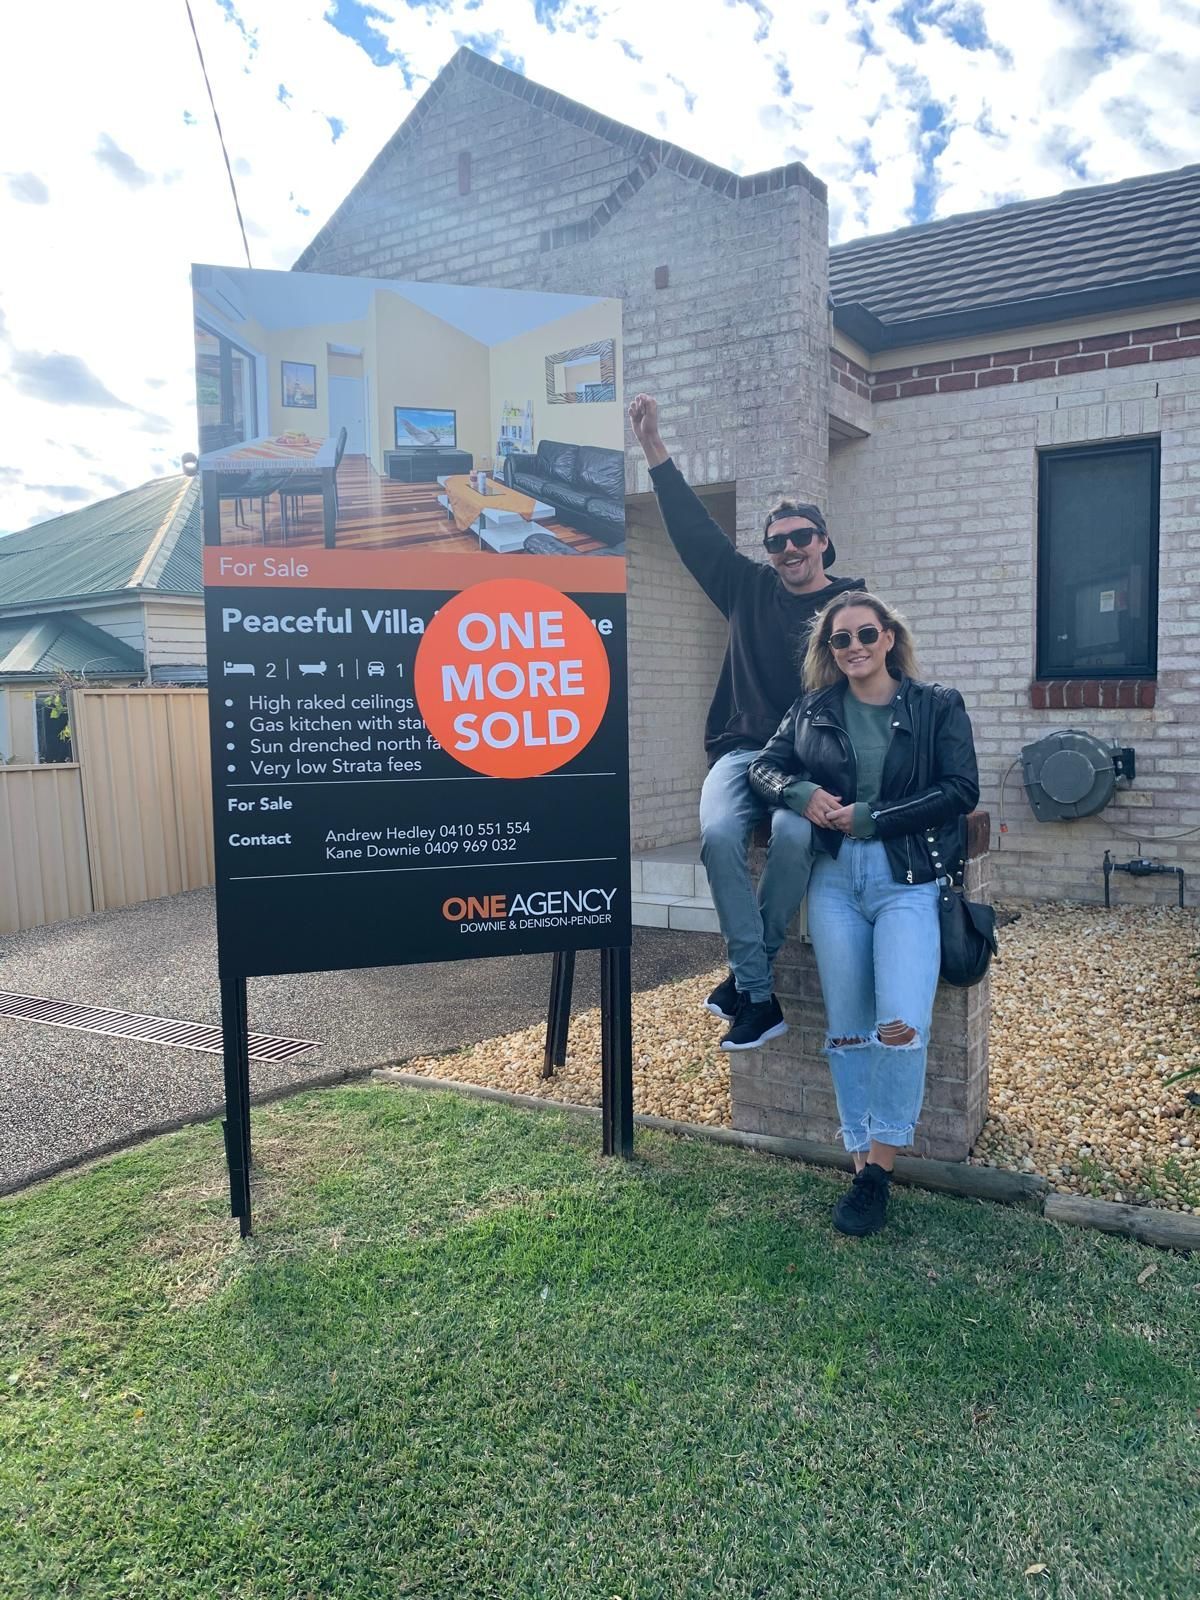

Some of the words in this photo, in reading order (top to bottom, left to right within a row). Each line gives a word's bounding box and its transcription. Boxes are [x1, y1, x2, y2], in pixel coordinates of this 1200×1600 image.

[219, 556, 257, 577] For
[262, 557, 309, 578] Sale
[222, 607, 353, 635] Peaceful
[361, 608, 425, 634] Villa
[457, 610, 565, 651] ONE
[265, 662, 277, 678] 2
[337, 663, 344, 678] 1
[396, 663, 403, 678] 1
[441, 659, 585, 702] MORE
[249, 694, 291, 714] High
[297, 693, 346, 710] raked
[351, 693, 414, 713] ceilings
[249, 716, 284, 732] Gas
[289, 715, 352, 732] kitchen
[356, 714, 393, 730] with
[397, 716, 426, 730] sta
[453, 708, 581, 751] SOLD
[250, 738, 283, 754] Sun
[289, 736, 371, 753] drenched
[377, 735, 421, 751] north
[250, 760, 291, 779] Very
[296, 757, 327, 774] low
[332, 756, 382, 774] Strata
[386, 756, 422, 772] fees
[228, 798, 256, 812] For
[259, 796, 293, 811] Sale
[228, 832, 292, 847] Contact
[325, 827, 383, 843] Andrew
[386, 823, 436, 843] Hedley
[439, 823, 474, 838] 0410
[477, 822, 501, 837] 551
[506, 821, 531, 836] 554
[326, 844, 363, 860] Kane
[366, 841, 421, 859] Downie
[424, 840, 459, 855] 0409
[462, 839, 488, 854] 969
[491, 838, 517, 852] 032
[460, 920, 507, 934] DOWNIE
[509, 919, 518, 930] &
[519, 914, 612, 930] DENISON-PENDER
